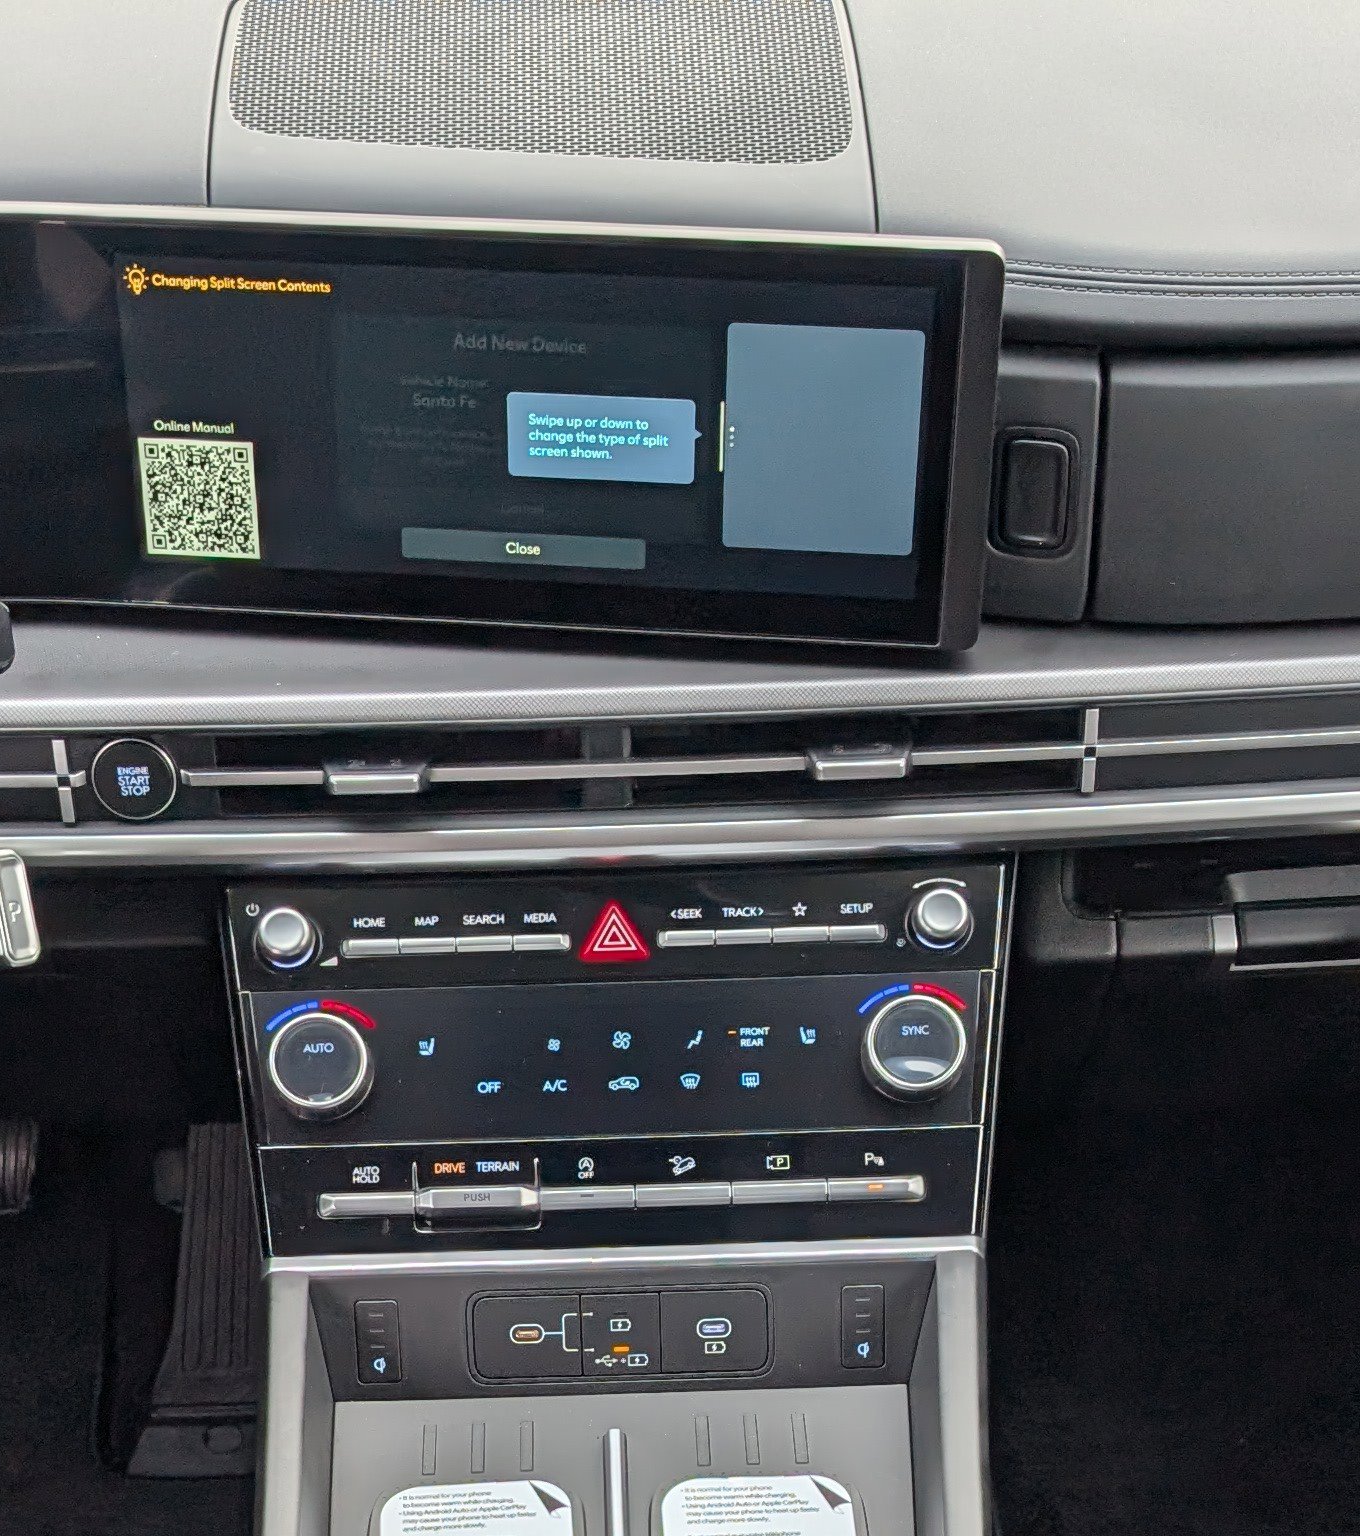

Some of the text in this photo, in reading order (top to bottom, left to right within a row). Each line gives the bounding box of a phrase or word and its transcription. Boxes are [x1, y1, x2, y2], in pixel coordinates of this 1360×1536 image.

[152, 273, 331, 293] Changing Split Screen Contents
[454, 333, 587, 354] Add New Device
[154, 419, 234, 434] Online Manual
[528, 413, 649, 430] Swipe up or down to
[528, 429, 669, 448] change the type of split
[529, 446, 613, 459] screen shown.
[505, 542, 540, 557] Close
[117, 766, 149, 776] ENGINE
[118, 776, 150, 786] START
[121, 786, 150, 796] STOP
[677, 908, 702, 919] SEEK
[722, 907, 758, 918] TRACK
[840, 902, 873, 915] SETUP
[353, 917, 385, 928] HOME
[414, 915, 439, 927] MAP
[462, 914, 505, 925] SEARCH
[523, 912, 557, 924] MEDIA
[740, 1026, 770, 1037] FRONT
[901, 1024, 929, 1037] SYNC
[303, 1042, 334, 1054] AUTO
[740, 1037, 763, 1047] REAR
[477, 1081, 502, 1094] OFF
[543, 1078, 567, 1093] A/C
[352, 1166, 380, 1176] AUTO
[434, 1162, 466, 1174] DRIVE
[476, 1161, 520, 1172] TERRAIN
[352, 1174, 380, 1184] HOLD
[578, 1171, 594, 1179] OFF
[463, 1192, 491, 1202] PUSH
